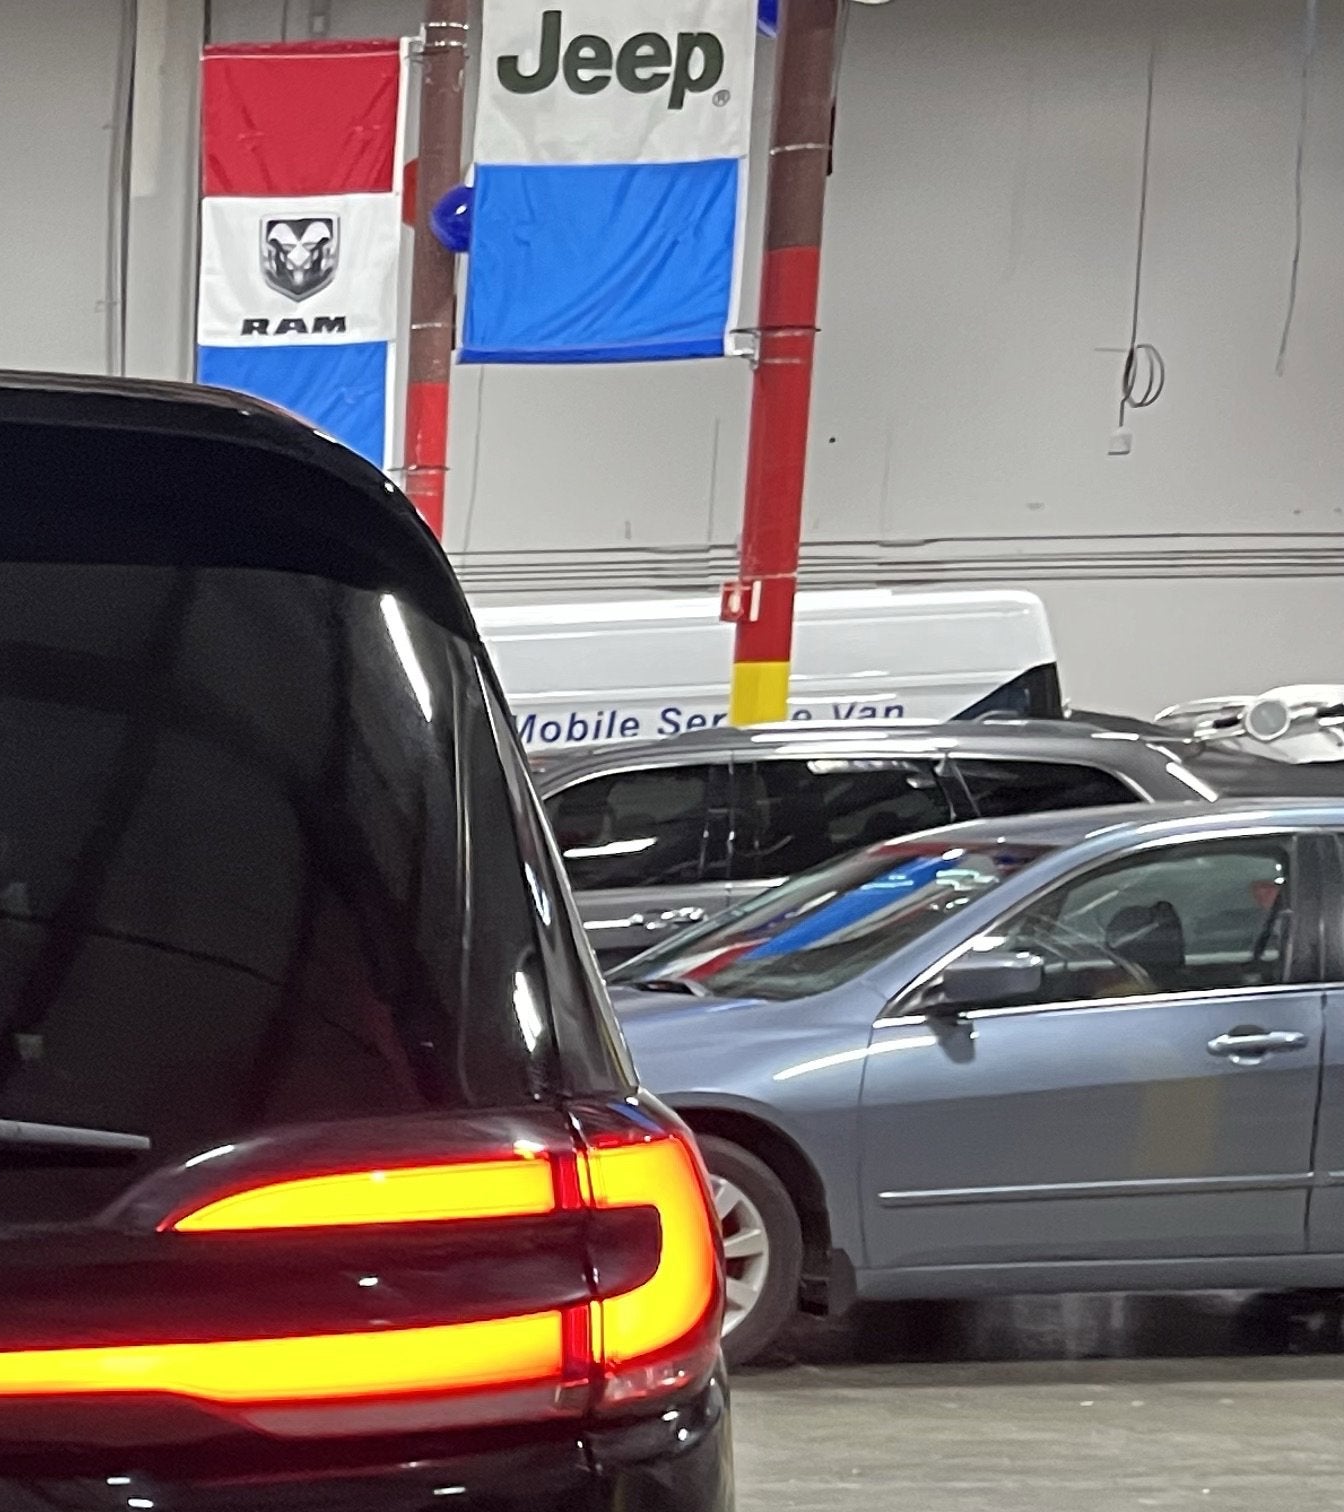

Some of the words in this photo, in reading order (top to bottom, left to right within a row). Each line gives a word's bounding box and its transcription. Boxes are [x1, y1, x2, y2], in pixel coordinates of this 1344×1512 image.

[497, 10, 724, 110] Jeep
[240, 316, 347, 336] RAM
[512, 710, 640, 744] Mobile
[657, 707, 812, 736] Sere
